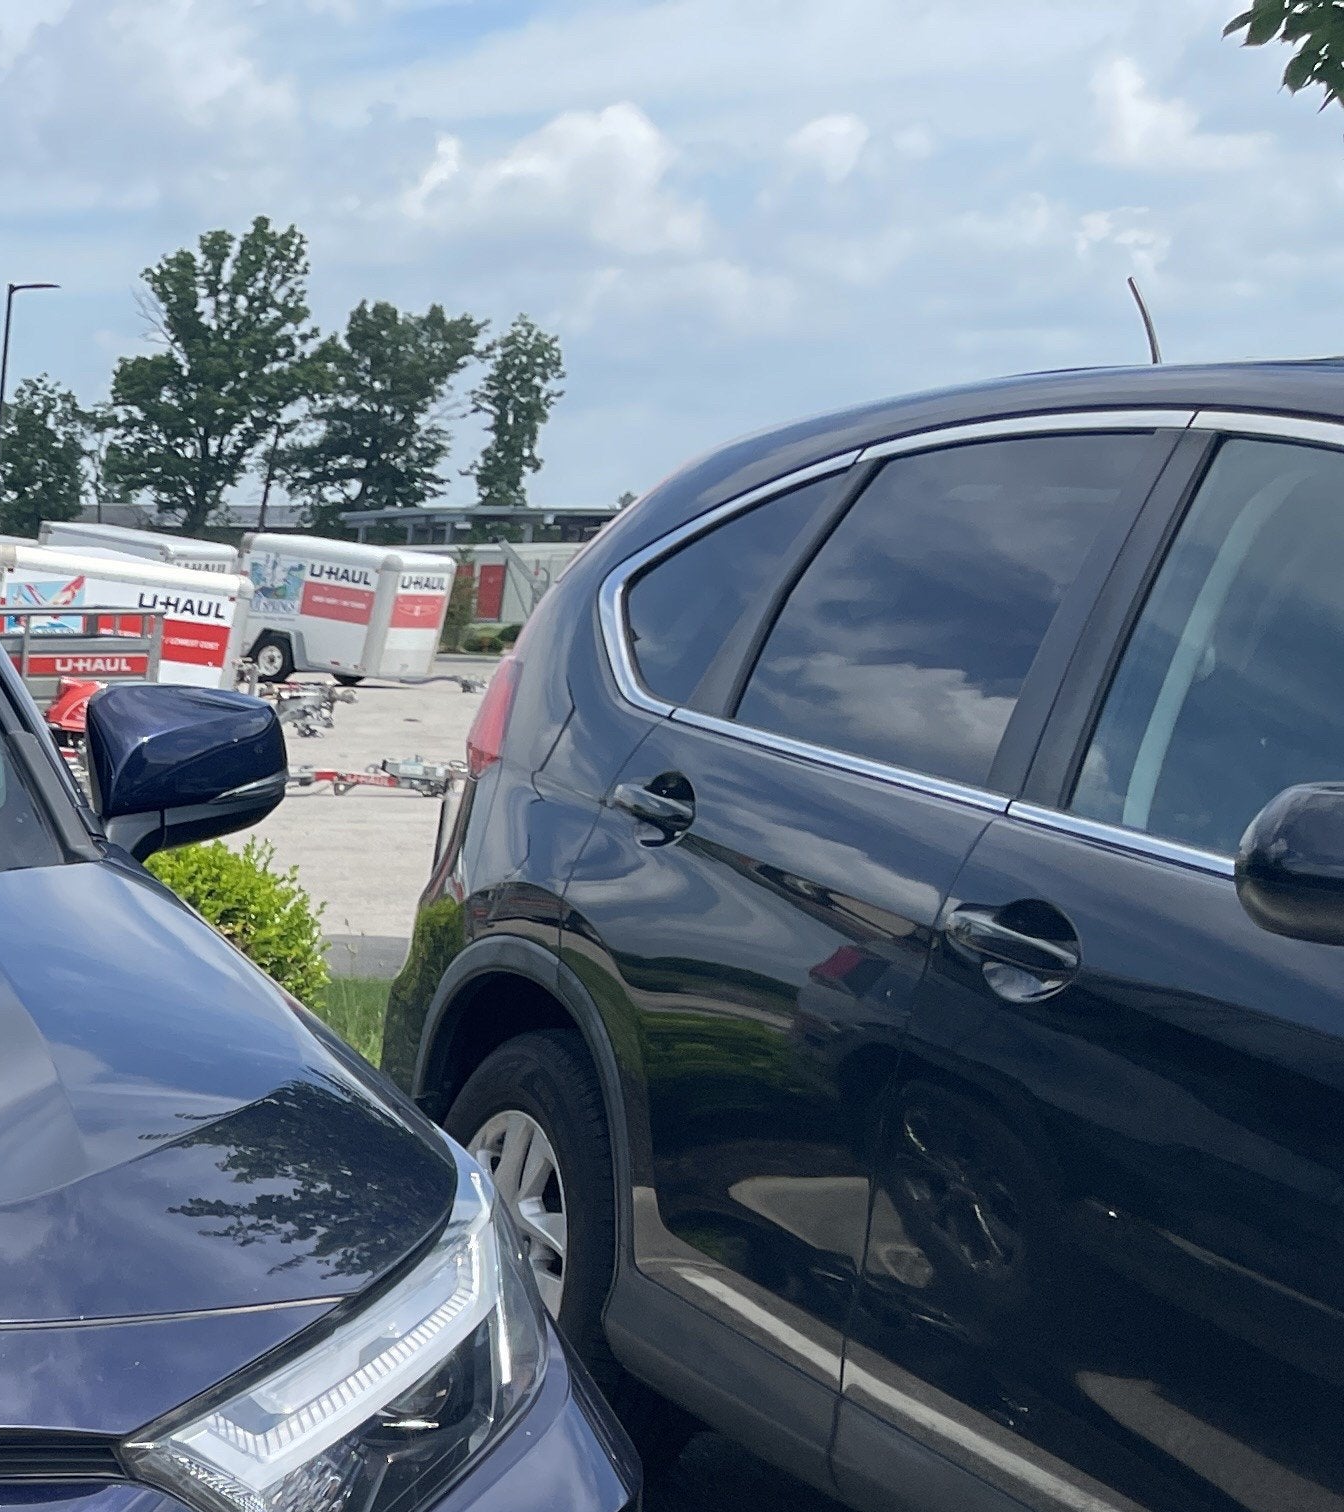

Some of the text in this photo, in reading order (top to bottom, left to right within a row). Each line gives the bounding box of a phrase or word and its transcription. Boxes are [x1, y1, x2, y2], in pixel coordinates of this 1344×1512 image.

[309, 564, 371, 587] U-HAUL
[400, 575, 445, 591] U-HAUL
[138, 591, 225, 619] U-HAUL
[55, 657, 132, 673] U-HAUL
